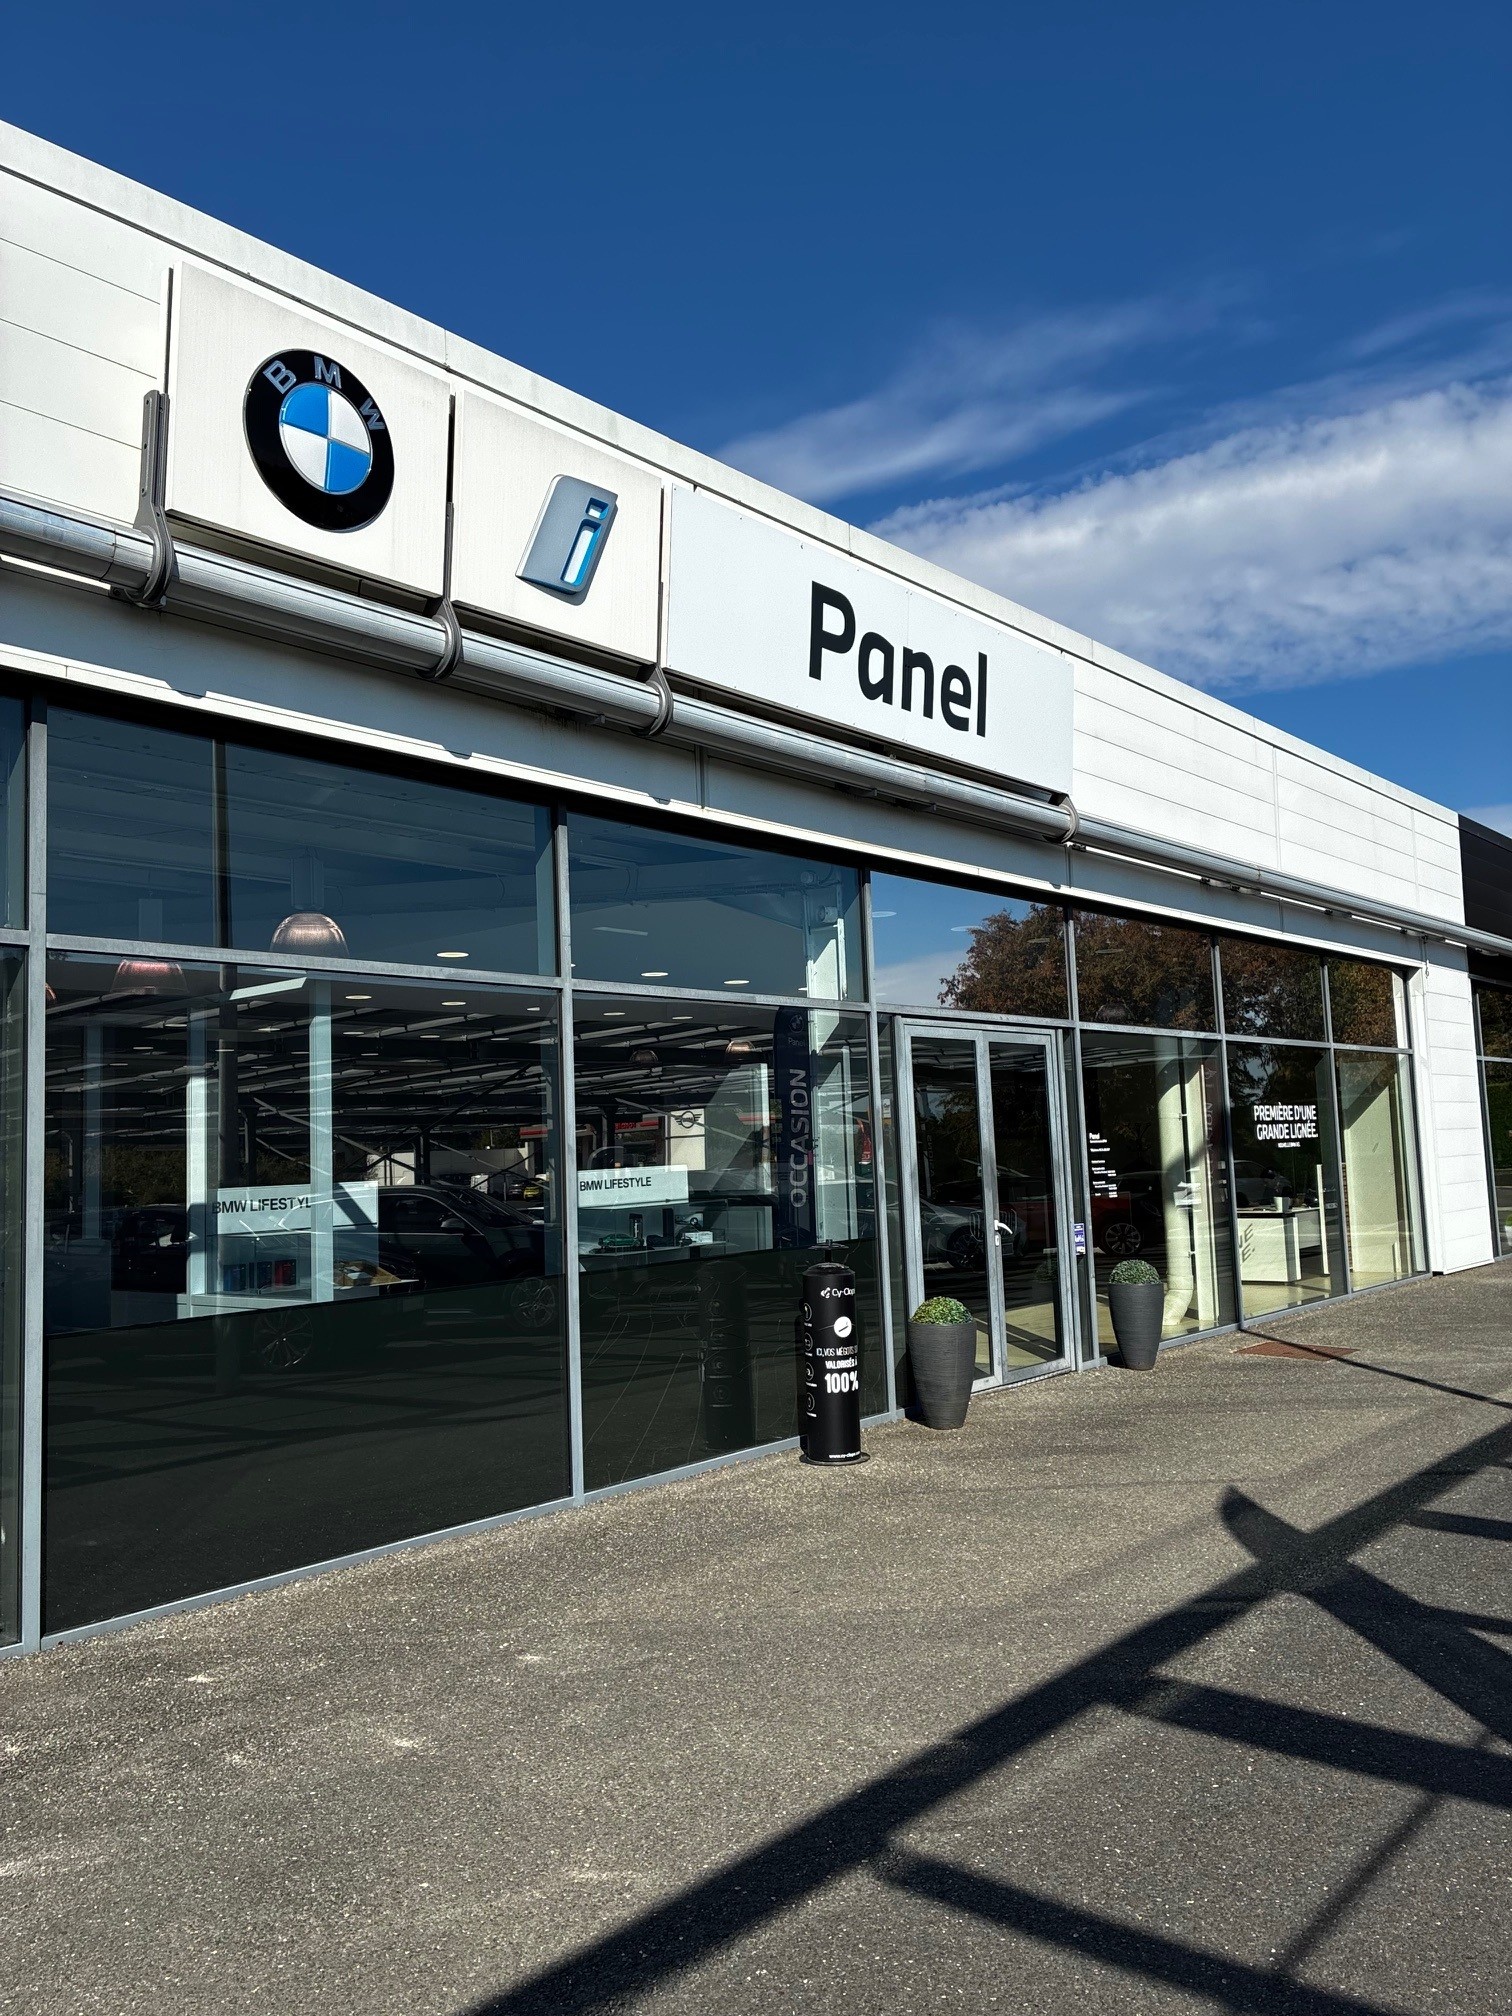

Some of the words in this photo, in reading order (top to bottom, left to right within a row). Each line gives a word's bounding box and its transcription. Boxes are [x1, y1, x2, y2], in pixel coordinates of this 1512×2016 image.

[263, 356, 386, 431] BMW
[809, 580, 987, 738] Panel
[1253, 1102, 1294, 1121] PREMIÈRE
[1294, 1104, 1317, 1120] D'UNE
[789, 1068, 810, 1208] OCCASION
[1256, 1123, 1290, 1140] GRANDE
[1290, 1120, 1318, 1139] LIGNÉE.
[580, 1180, 603, 1191] BMW
[604, 1177, 652, 1189] LIFESTYLE
[212, 1200, 247, 1214] BMW
[250, 1197, 311, 1212] LIFESTYL
[825, 1371, 859, 1394] 100%
